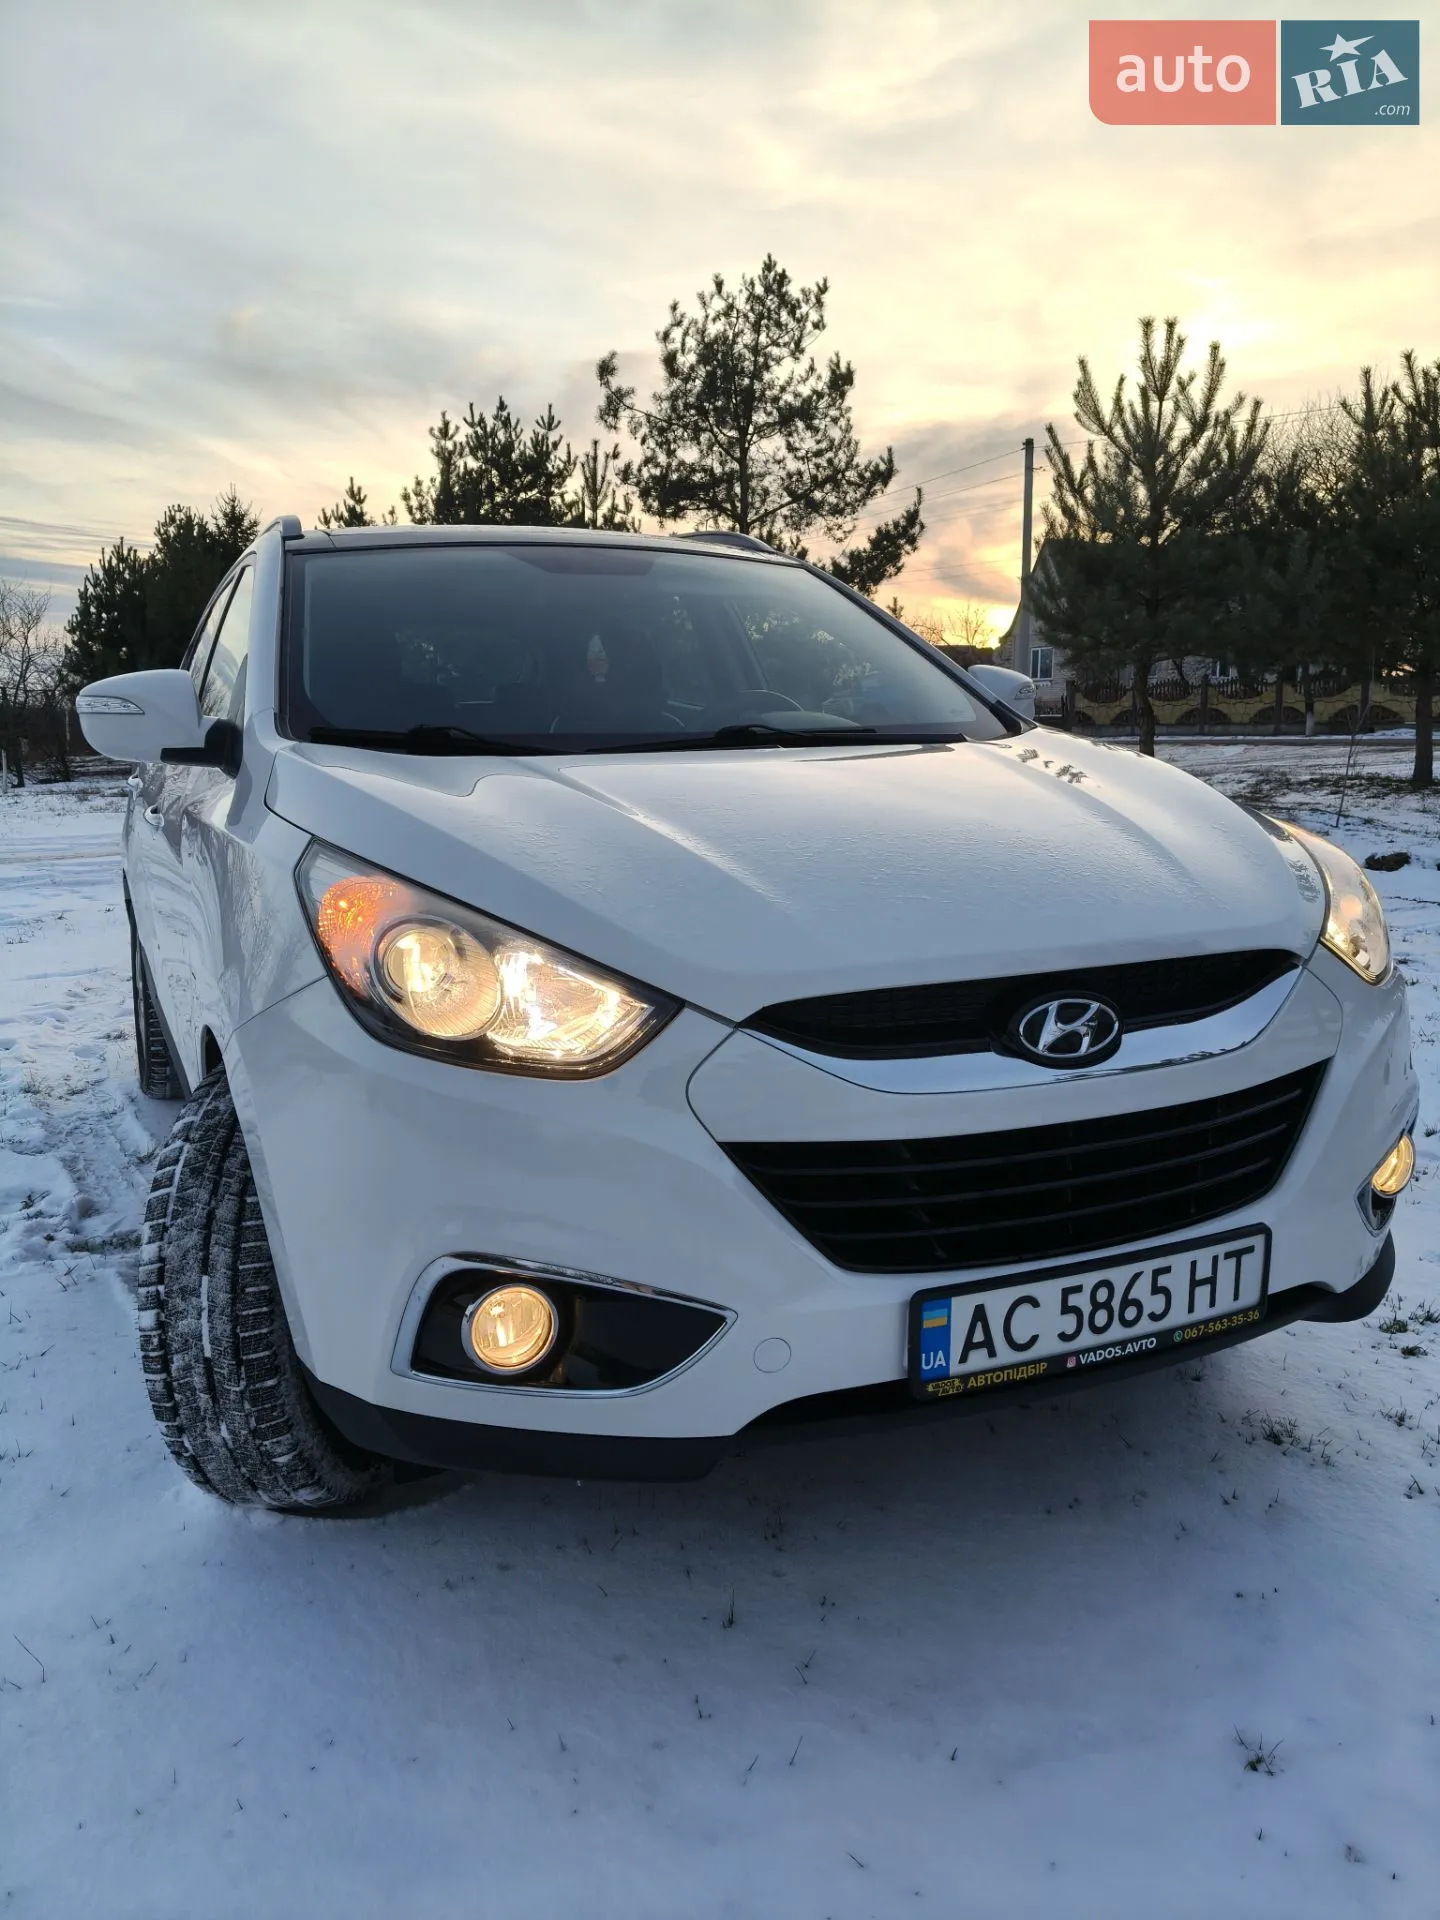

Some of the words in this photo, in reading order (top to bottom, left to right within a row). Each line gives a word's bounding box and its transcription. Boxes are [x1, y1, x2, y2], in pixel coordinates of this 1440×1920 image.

[957, 1294, 1041, 1364] AC
[1057, 1265, 1173, 1343] 5865
[1187, 1245, 1255, 1315] HT
[1184, 1310, 1260, 1340] 067-563-35-36
[921, 1349, 947, 1370] UA
[1079, 1337, 1157, 1364] VADOS.AVTO
[966, 1362, 1048, 1389] АВТОПІДБІР
